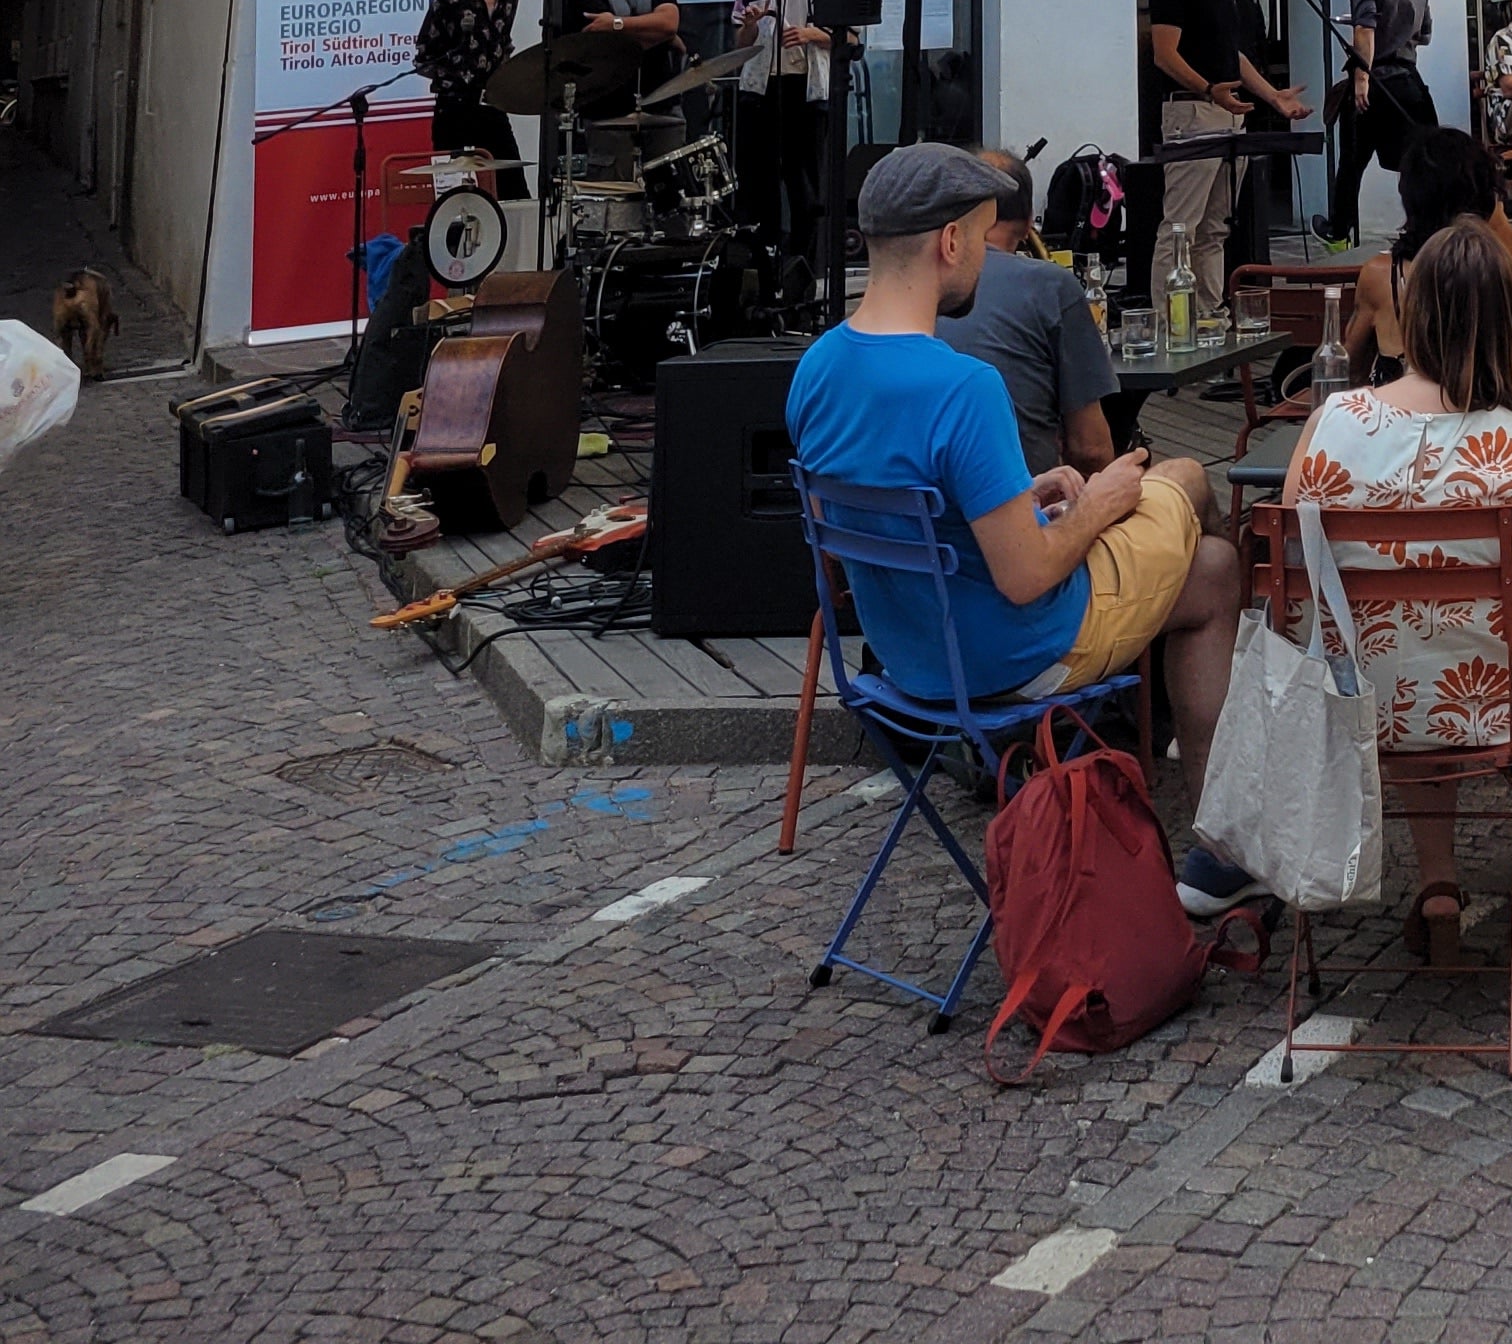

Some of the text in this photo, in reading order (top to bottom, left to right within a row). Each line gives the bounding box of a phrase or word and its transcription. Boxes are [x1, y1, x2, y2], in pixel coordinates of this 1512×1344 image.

[280, 18, 361, 39] EUREGIO
[281, 38, 316, 55] Tirol
[322, 33, 384, 52] Südtirol
[281, 48, 411, 71] Tirolo Alto Adige
